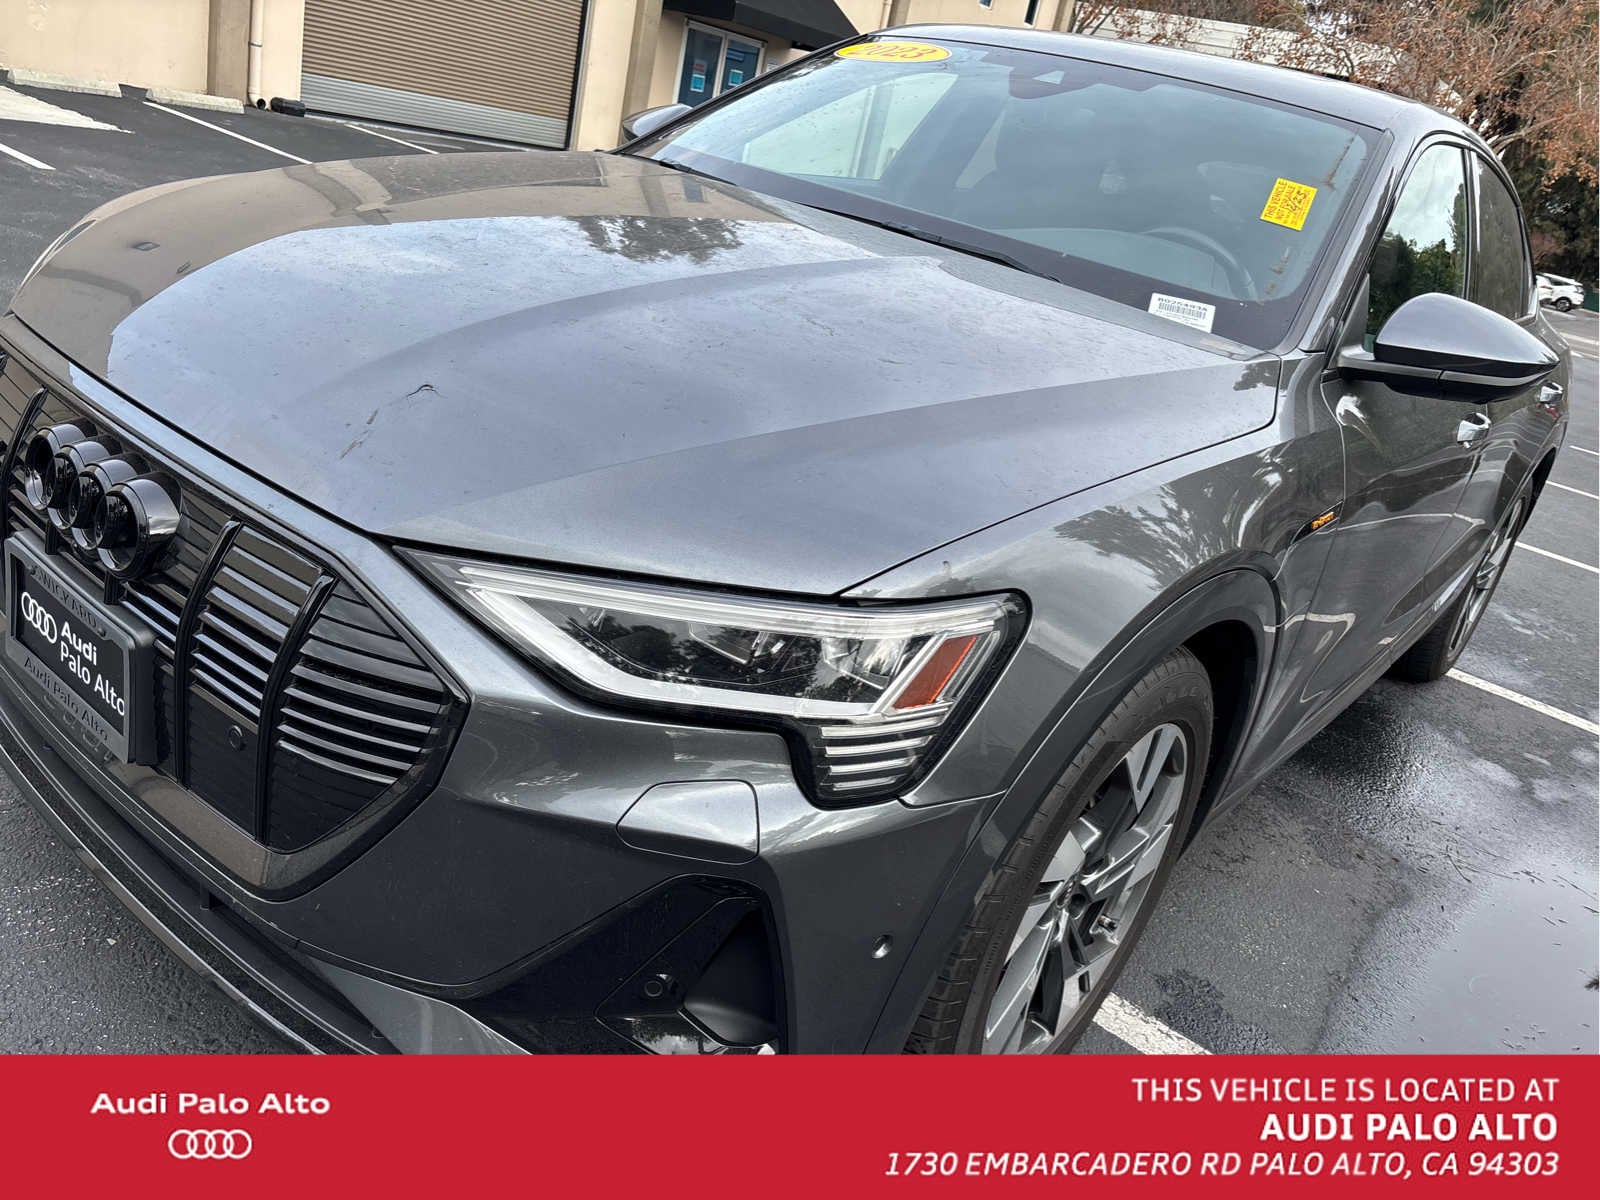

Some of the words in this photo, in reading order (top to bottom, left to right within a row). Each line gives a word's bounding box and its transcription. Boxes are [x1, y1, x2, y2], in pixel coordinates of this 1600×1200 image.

[847, 44, 937, 59] 2023
[61, 621, 97, 666] Audi
[24, 657, 50, 688] Audi
[53, 681, 79, 714] Palo
[81, 710, 108, 741] Alto
[60, 640, 91, 685] Palo
[94, 673, 125, 716] Alto
